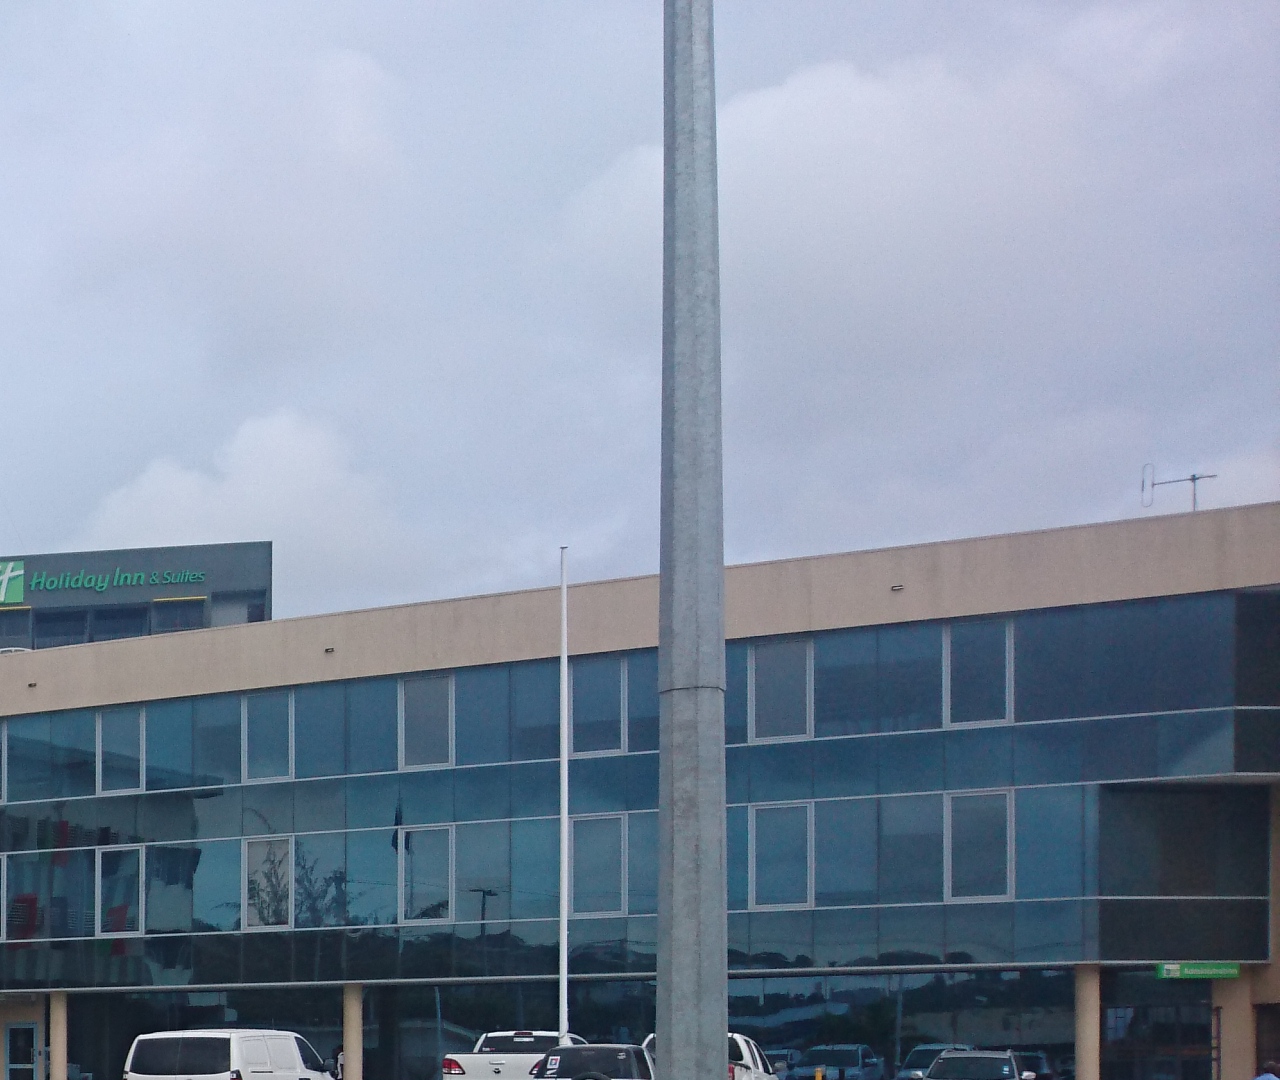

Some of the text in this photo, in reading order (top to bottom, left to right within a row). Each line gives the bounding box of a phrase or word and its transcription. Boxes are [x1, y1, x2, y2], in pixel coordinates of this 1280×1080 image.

[29, 567, 206, 592] Holiday Inn & Suites
